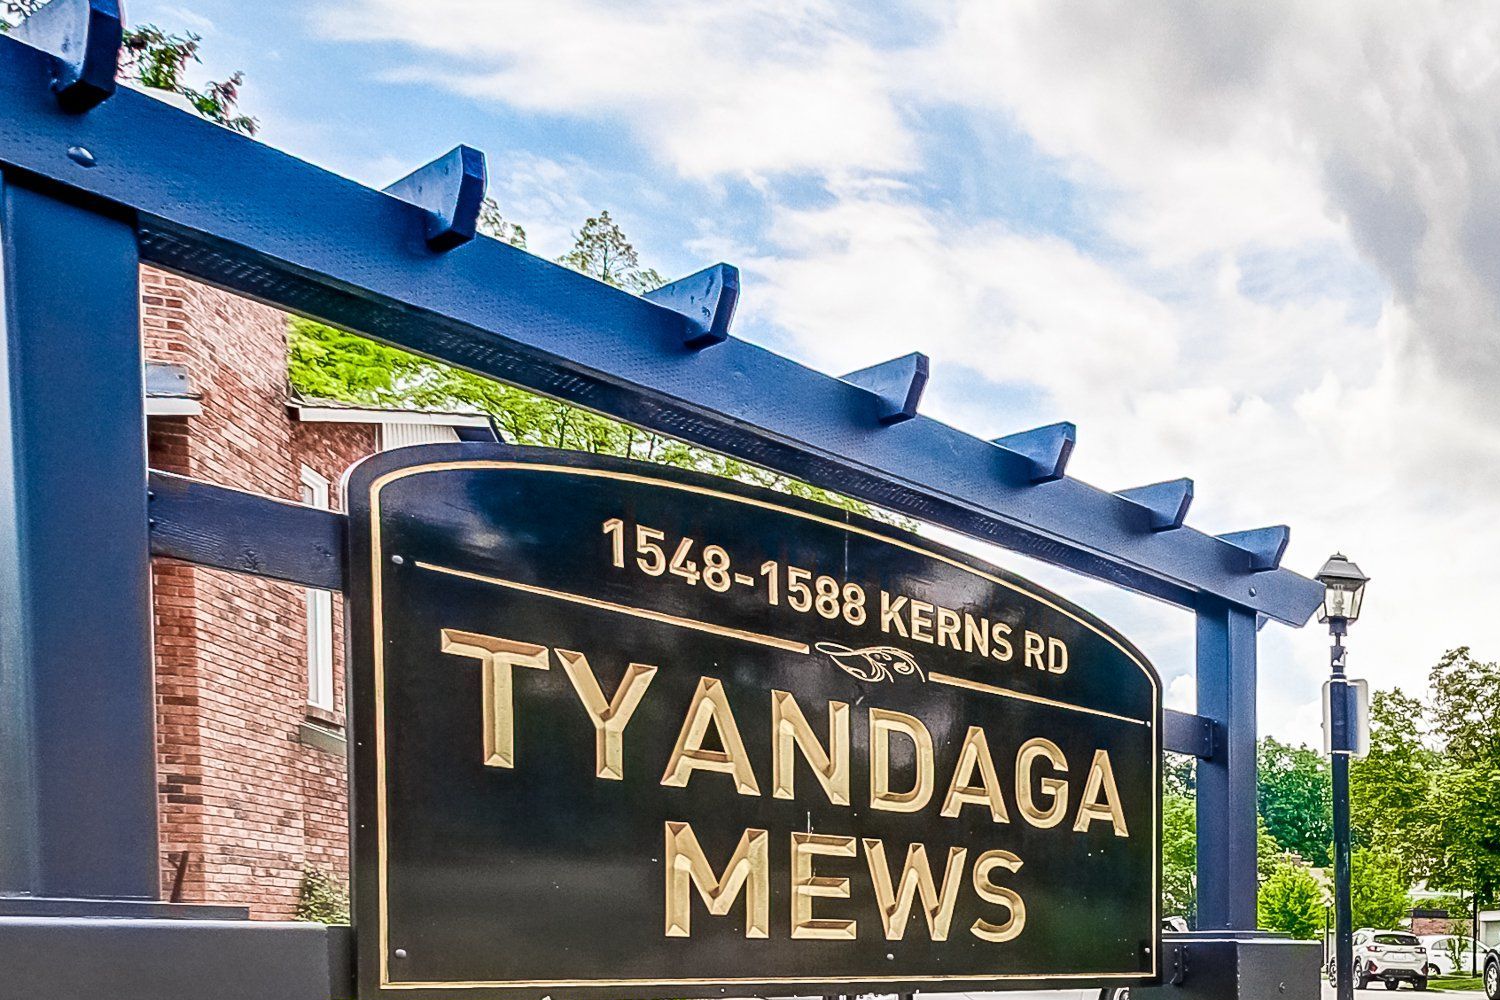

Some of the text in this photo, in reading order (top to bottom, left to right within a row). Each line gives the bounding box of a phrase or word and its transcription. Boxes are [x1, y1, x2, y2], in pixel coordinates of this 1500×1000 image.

[601, 517, 1069, 675] 1548-1588 KERNS RD
[440, 627, 1130, 838] TYANDAGA
[664, 820, 1027, 943] MEWS
